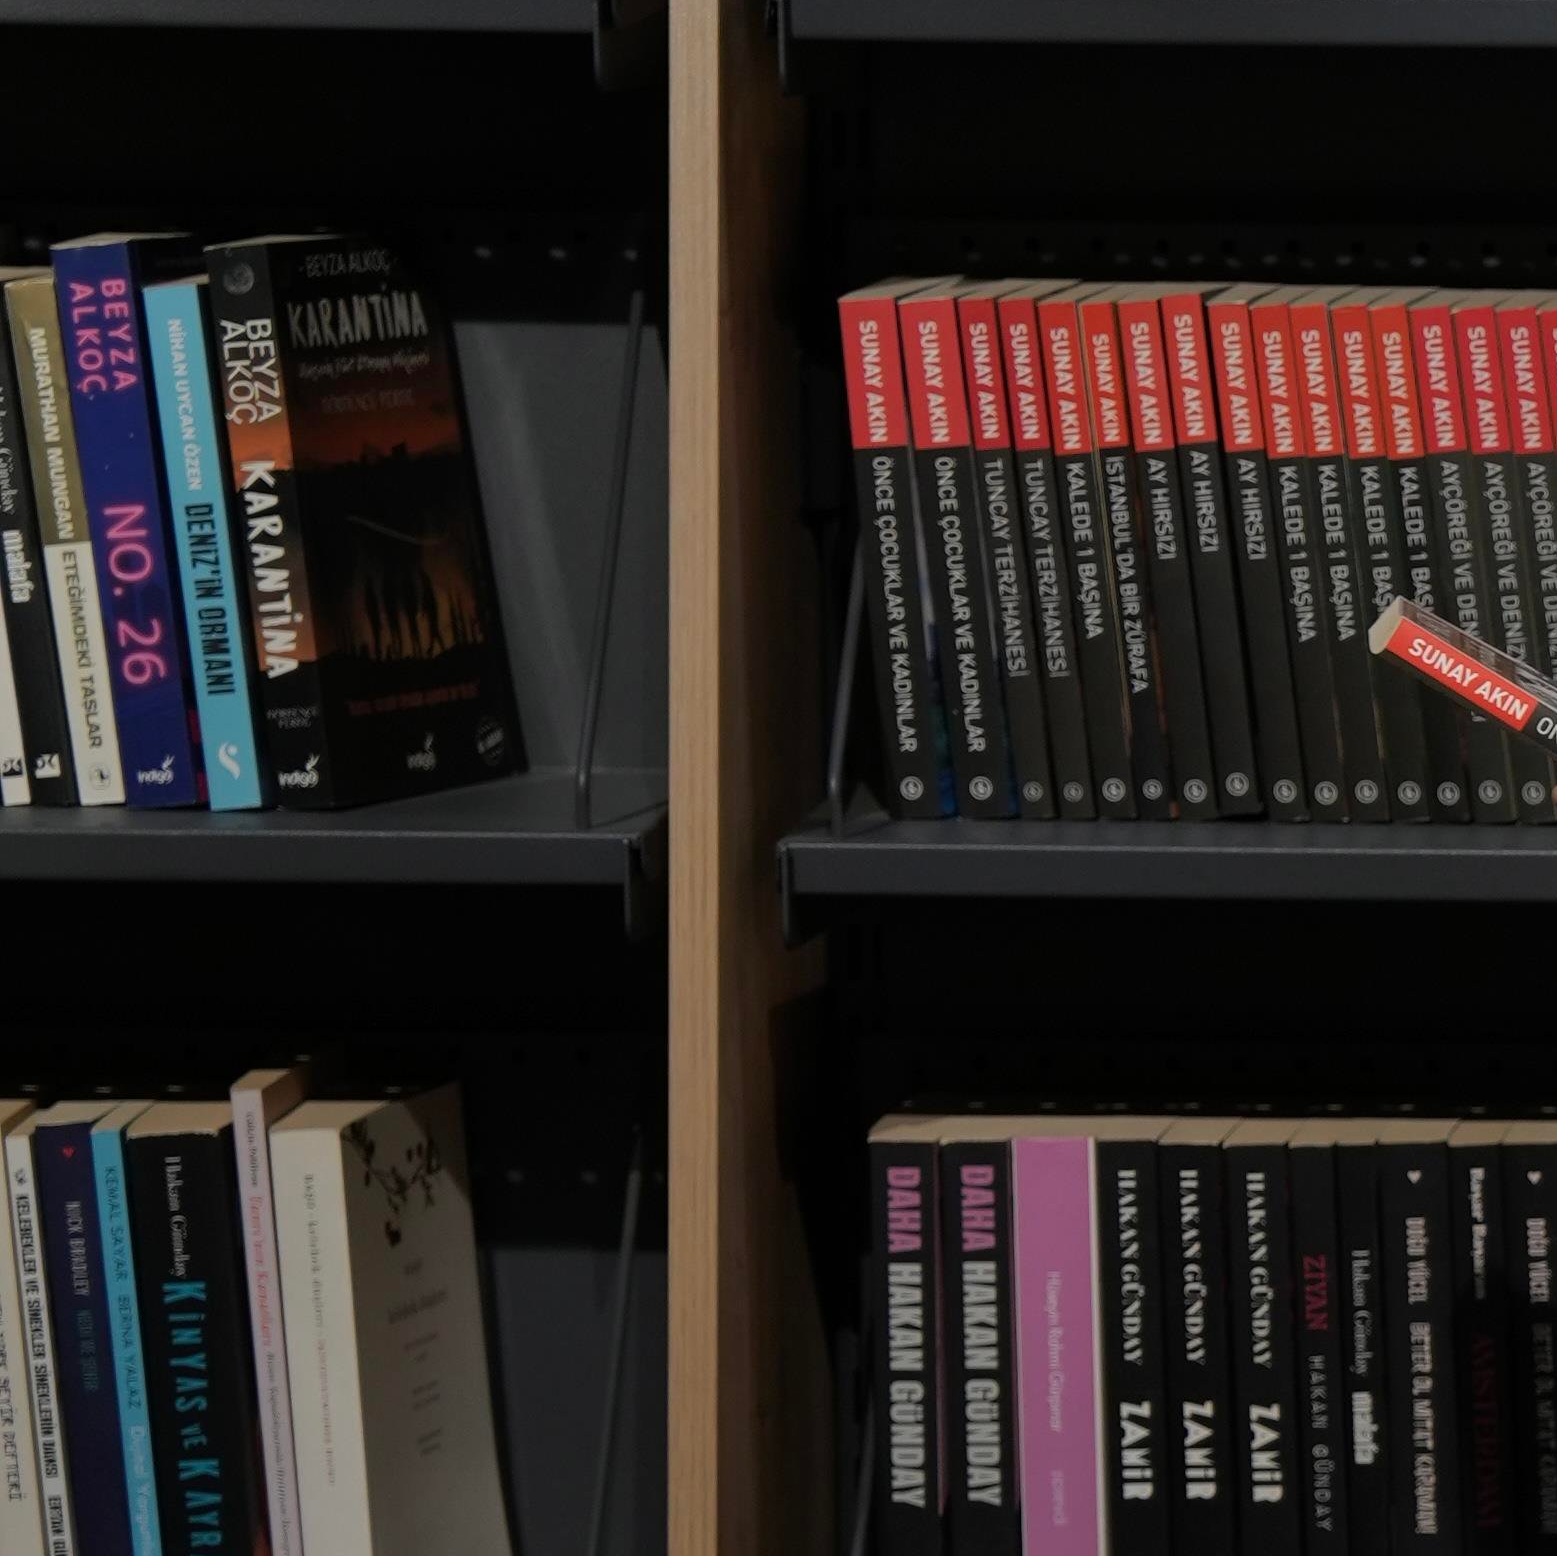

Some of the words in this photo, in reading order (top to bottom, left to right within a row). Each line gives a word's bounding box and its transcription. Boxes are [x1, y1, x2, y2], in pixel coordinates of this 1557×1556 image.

[69, 281, 106, 394] ALKOÇ
[101, 278, 138, 392] BEYZA
[29, 327, 61, 442] MURATHAN
[49, 446, 74, 540] MUNGAN
[872, 455, 895, 512] ÖNCE
[103, 503, 152, 596] NO.
[238, 459, 303, 679] KARANTİNA
[875, 516, 905, 623] ÇOCUKLAR
[116, 618, 165, 686] 26
[889, 622, 908, 652] VE
[1406, 636, 1478, 698] SUNAY
[1474, 682, 1530, 723] AKIN
[893, 653, 918, 754] KADINLAR
[887, 1166, 922, 1254] DAHA
[163, 1280, 208, 1413] KİNYAS
[888, 1262, 924, 1372] HAKAN
[889, 1381, 926, 1509] GÜNDAY
